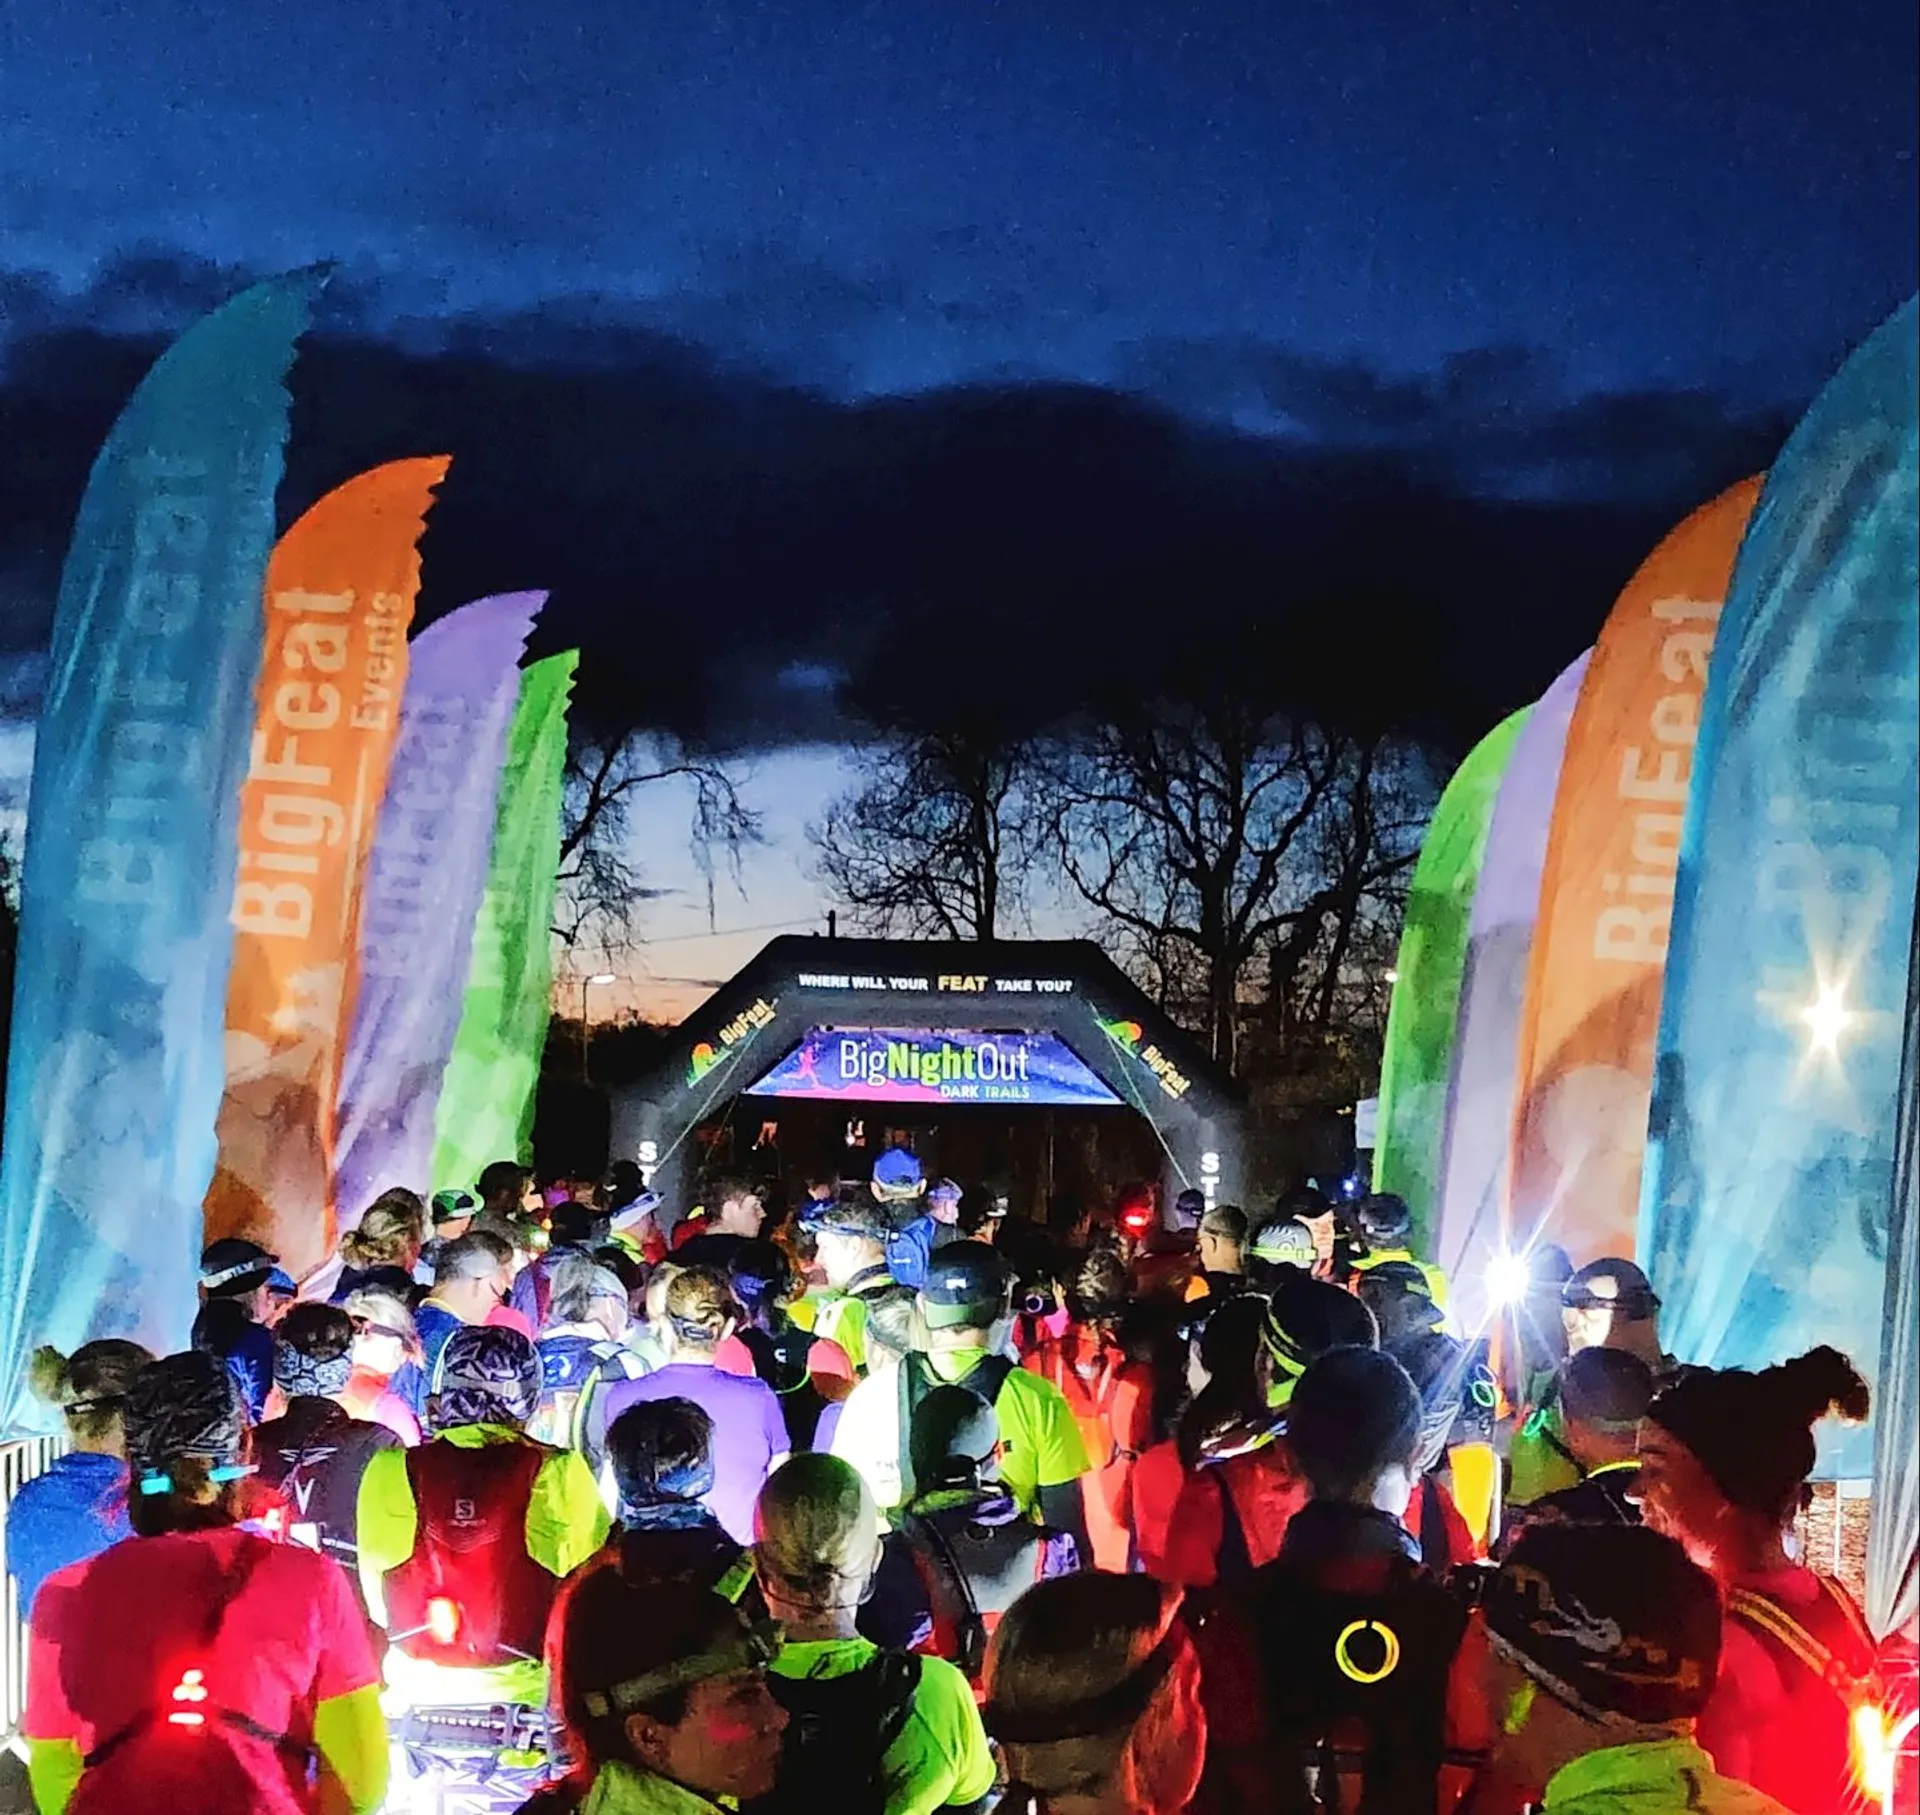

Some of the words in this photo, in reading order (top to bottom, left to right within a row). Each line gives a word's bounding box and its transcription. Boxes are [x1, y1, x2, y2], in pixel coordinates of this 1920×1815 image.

[350, 590, 403, 731] Events
[230, 586, 355, 939] BigFeat
[798, 974, 850, 988] WHERE
[851, 976, 886, 989] WILL
[889, 977, 929, 991] YOUR
[938, 975, 988, 992] FEAT
[995, 979, 1031, 992] TAKE
[1036, 979, 1073, 993] YOU?
[719, 997, 771, 1046] BigFeat
[840, 1039, 1029, 1087] BigNightOut
[1141, 1045, 1191, 1095] BigFeat
[941, 1085, 979, 1099] DARK
[985, 1086, 1030, 1099] TRAILS
